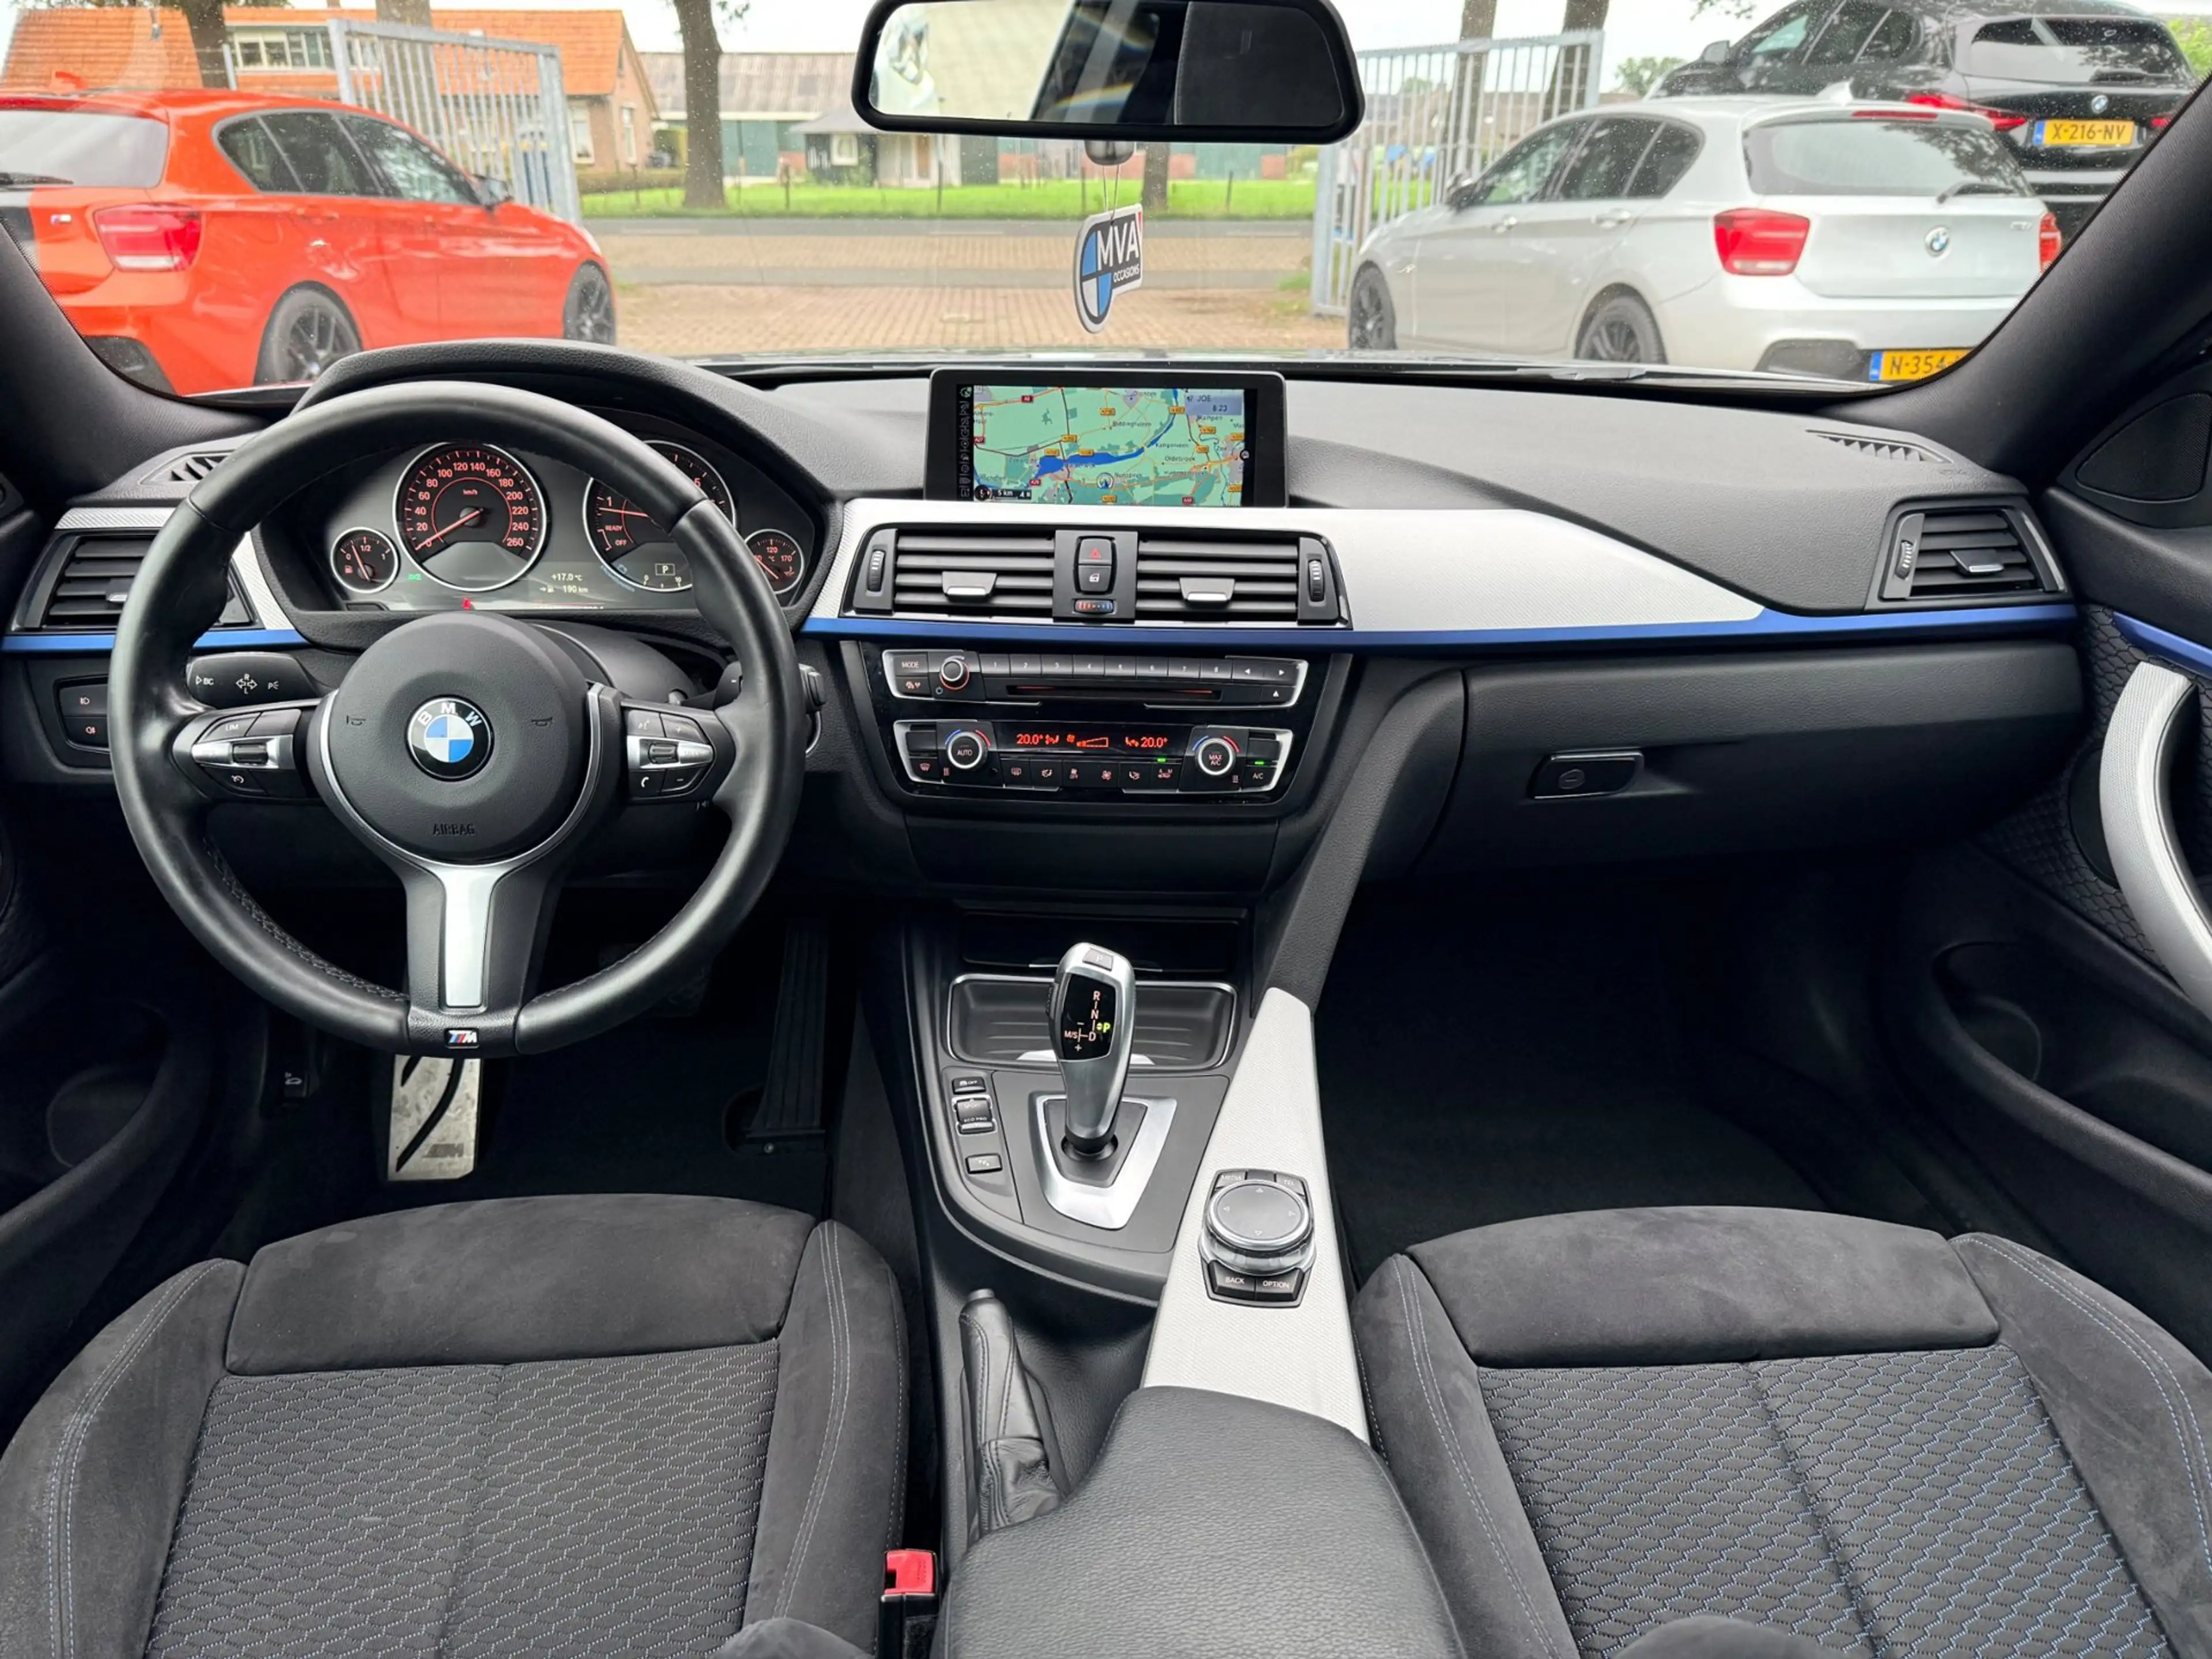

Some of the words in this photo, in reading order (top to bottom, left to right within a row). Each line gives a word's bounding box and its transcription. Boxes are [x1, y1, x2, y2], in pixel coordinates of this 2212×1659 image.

[2052, 123, 2126, 141] X-216-NV
[1097, 221, 1139, 271] MVA
[452, 463, 468, 471] 120
[469, 463, 486, 471] 140
[437, 469, 453, 478] 100
[486, 469, 501, 478] 160
[426, 479, 438, 487] 80
[499, 478, 514, 487] 180
[418, 491, 430, 500] 60
[506, 491, 523, 500] 200
[607, 497, 612, 506] 1
[414, 506, 426, 515] 40
[512, 506, 529, 515] 220
[416, 522, 428, 531] 20
[512, 522, 529, 531] 240
[506, 538, 524, 547] 260
[662, 565, 669, 574] P
[203, 677, 214, 685] BC
[417, 702, 482, 727] BMW
[433, 824, 475, 836] AIRBAG
[1093, 990, 1101, 1001] R
[1090, 1009, 1099, 1020] N
[1103, 1022, 1111, 1033] P
[1064, 1030, 1078, 1039] M/S
[1088, 1031, 1097, 1041] D
[1225, 1277, 1245, 1285] BACK
[1262, 1280, 1290, 1289] OPTION
